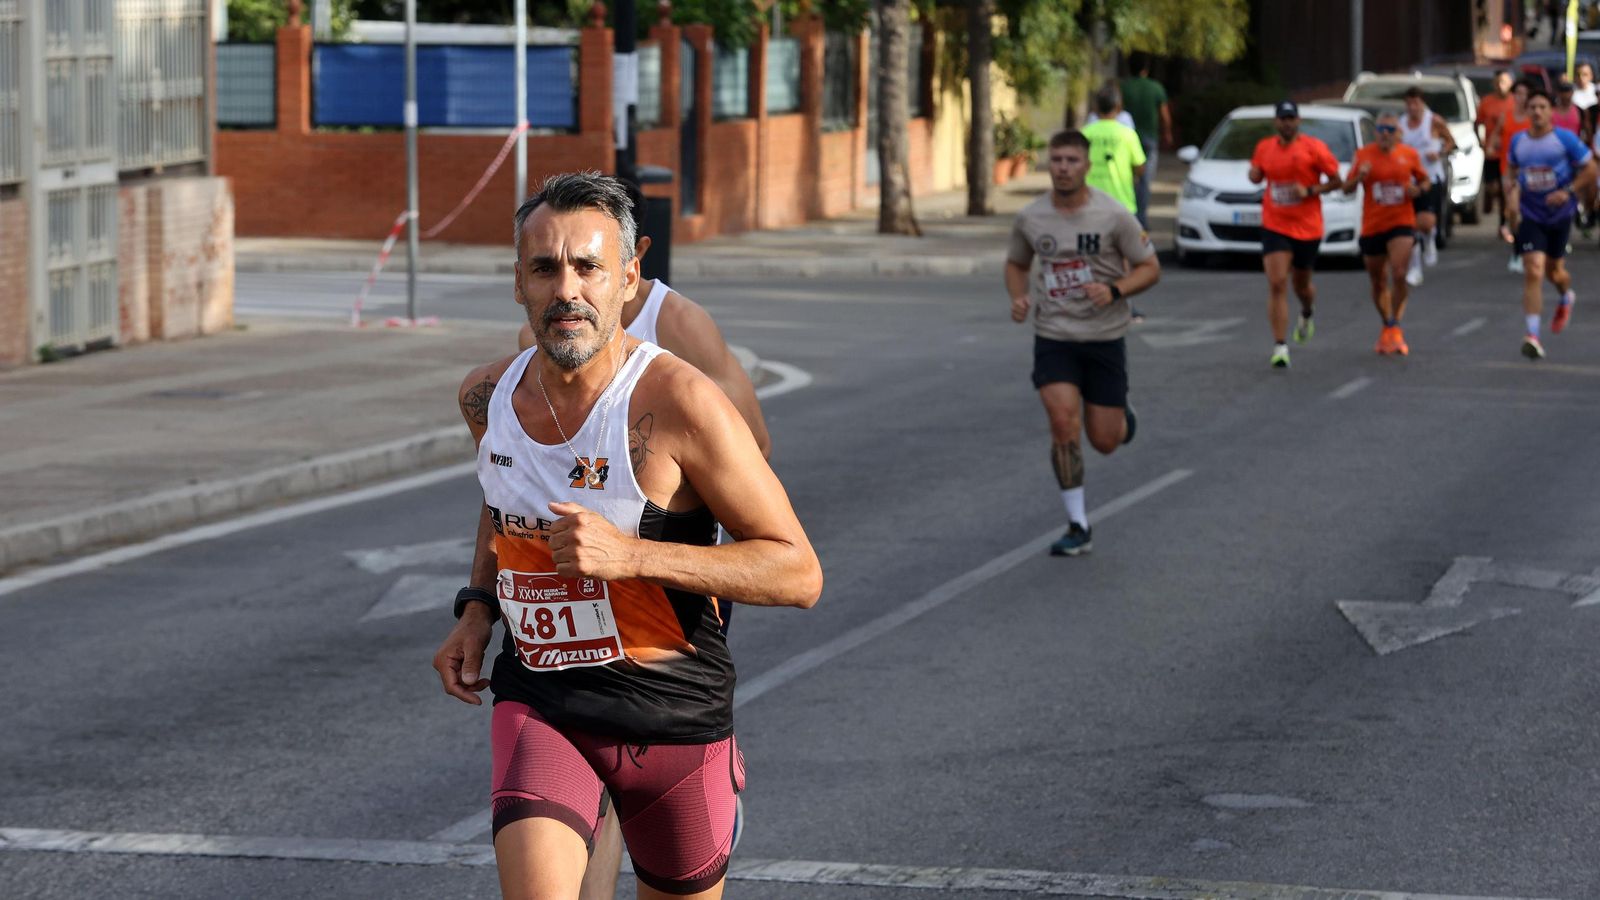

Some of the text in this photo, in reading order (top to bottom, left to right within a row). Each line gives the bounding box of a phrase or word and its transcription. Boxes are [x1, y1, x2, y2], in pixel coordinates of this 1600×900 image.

[583, 579, 594, 588] 21
[518, 588, 544, 600] XXIX
[520, 606, 577, 640] 481
